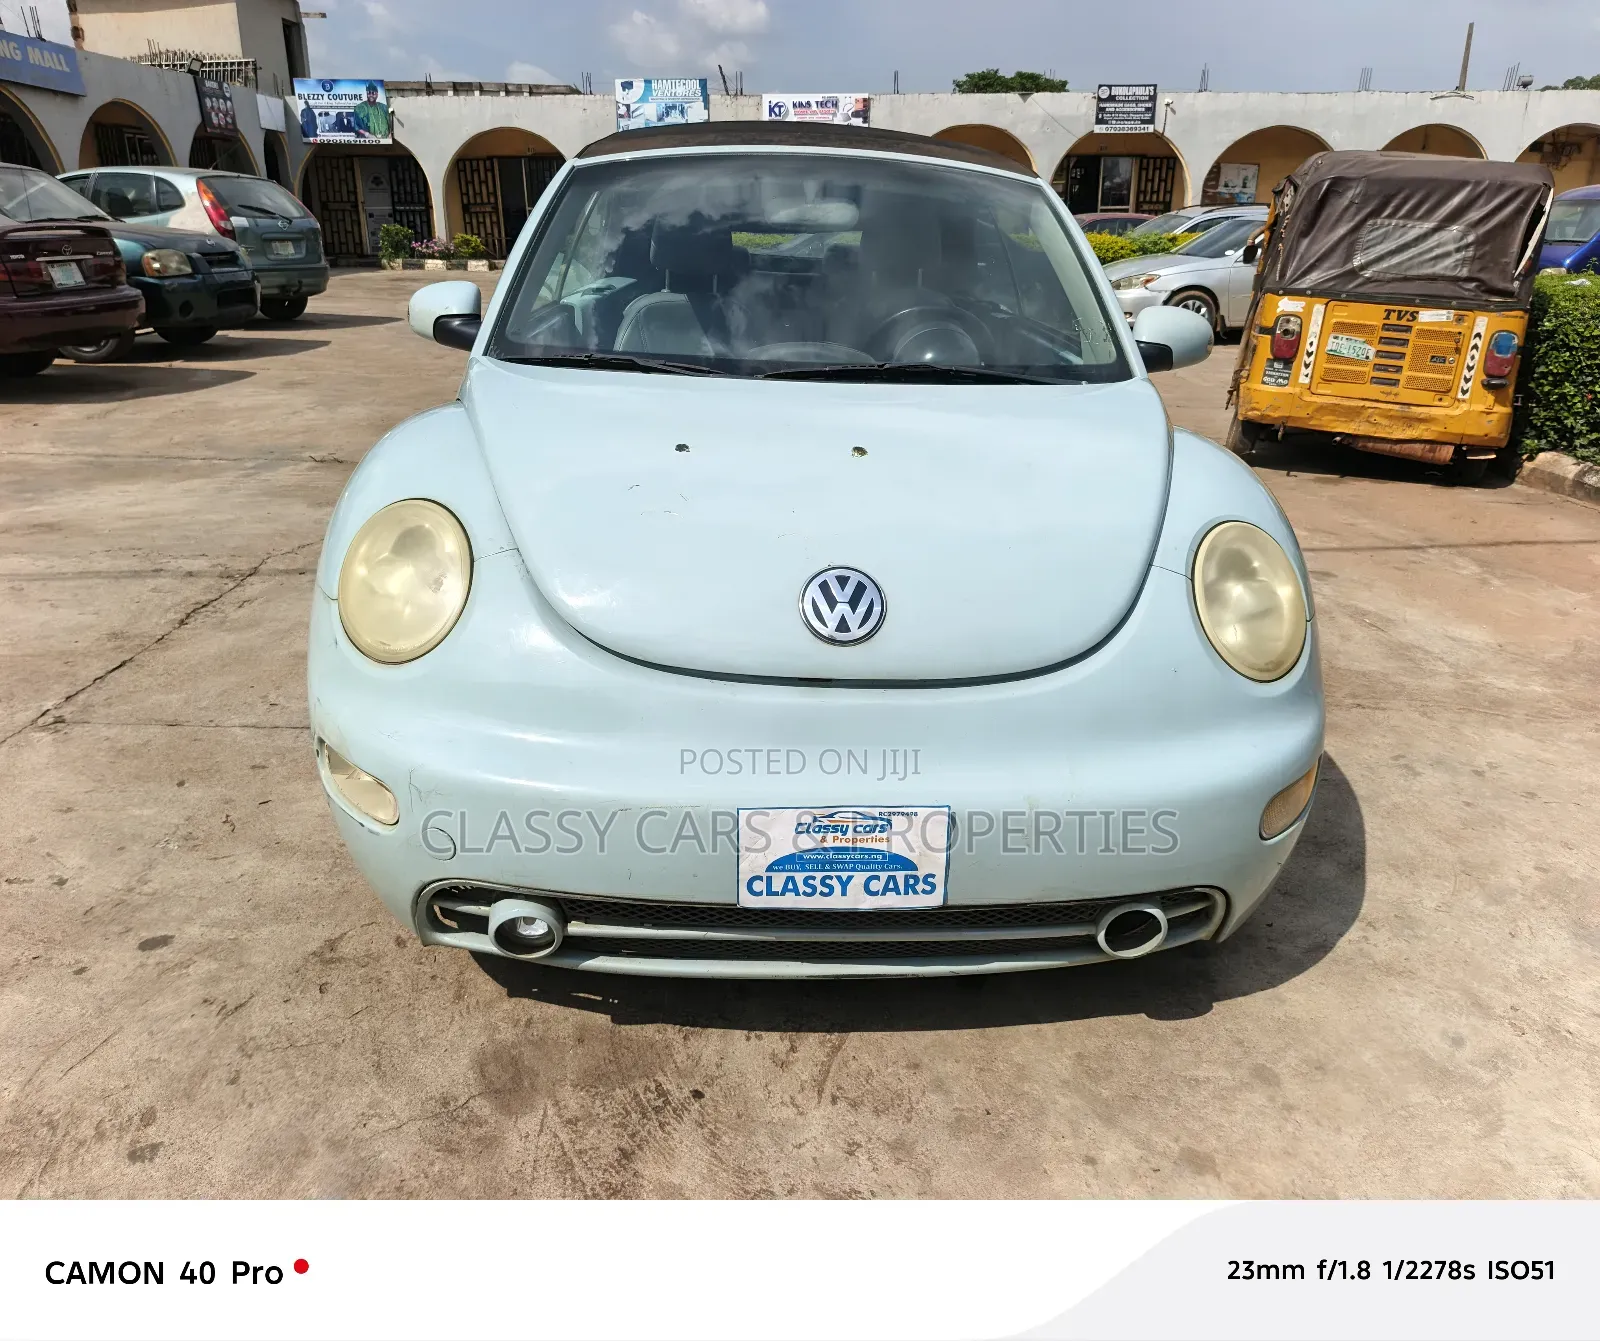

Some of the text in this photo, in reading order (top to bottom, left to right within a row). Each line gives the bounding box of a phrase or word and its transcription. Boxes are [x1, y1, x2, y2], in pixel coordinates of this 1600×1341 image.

[26, 45, 71, 73] MALL
[652, 80, 702, 90] HAMTECOOL
[792, 101, 838, 109] KINS TECH
[1383, 309, 1419, 322] TVS
[794, 822, 849, 836] Classy
[820, 835, 890, 844] & Properties
[803, 853, 883, 861] www.classycars.ng
[855, 863, 882, 871] Quality
[746, 873, 937, 897] CLASSY CARS
